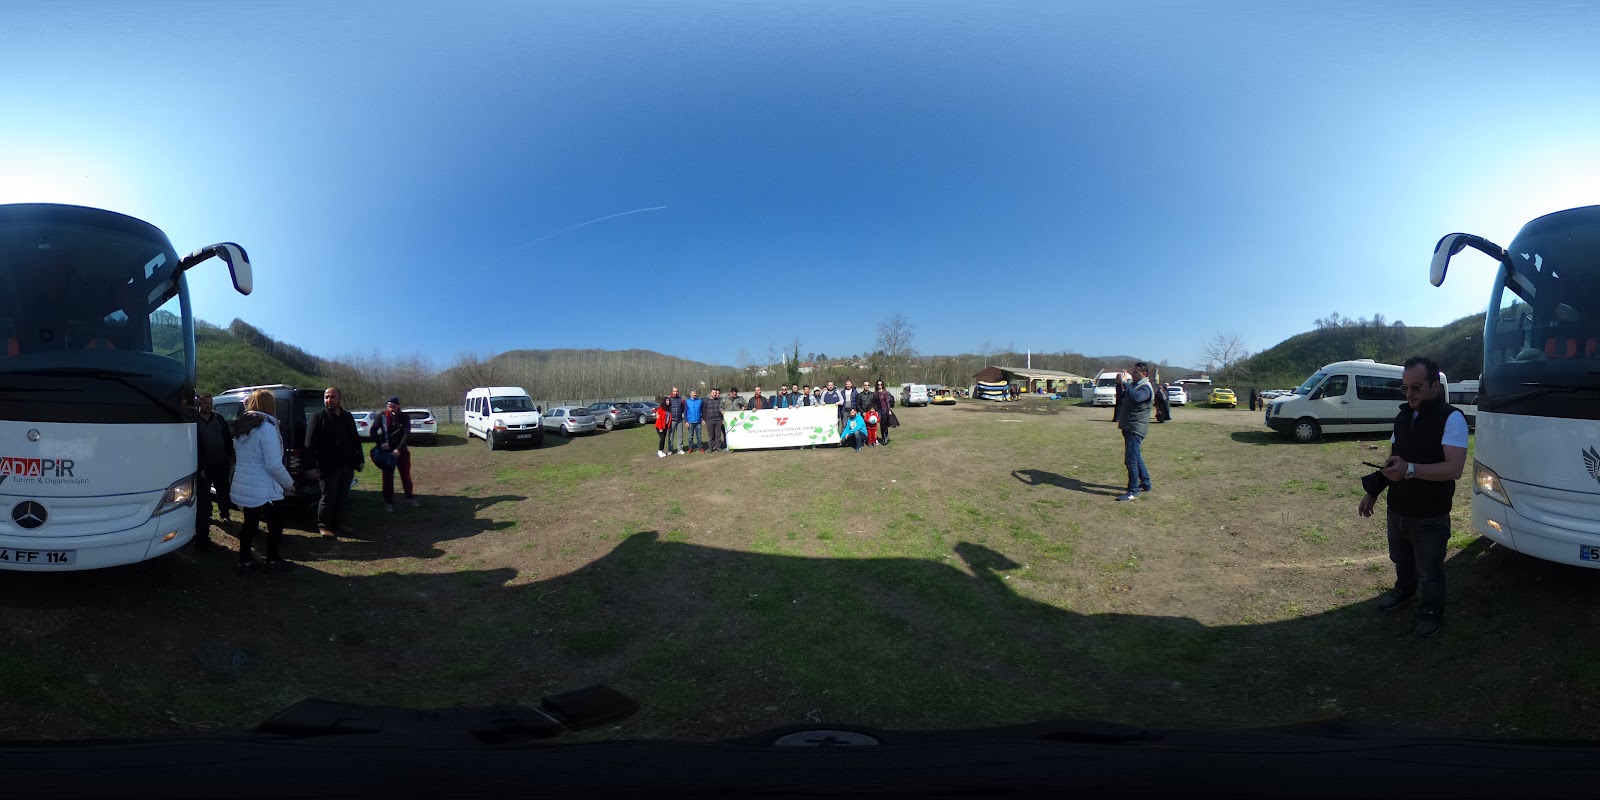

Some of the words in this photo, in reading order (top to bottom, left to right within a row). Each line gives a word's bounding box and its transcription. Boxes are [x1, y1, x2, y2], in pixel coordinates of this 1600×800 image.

[13, 476, 36, 484] Turizm
[45, 477, 89, 485] Organizasyon
[16, 551, 39, 562] FF
[46, 552, 68, 562] 114
